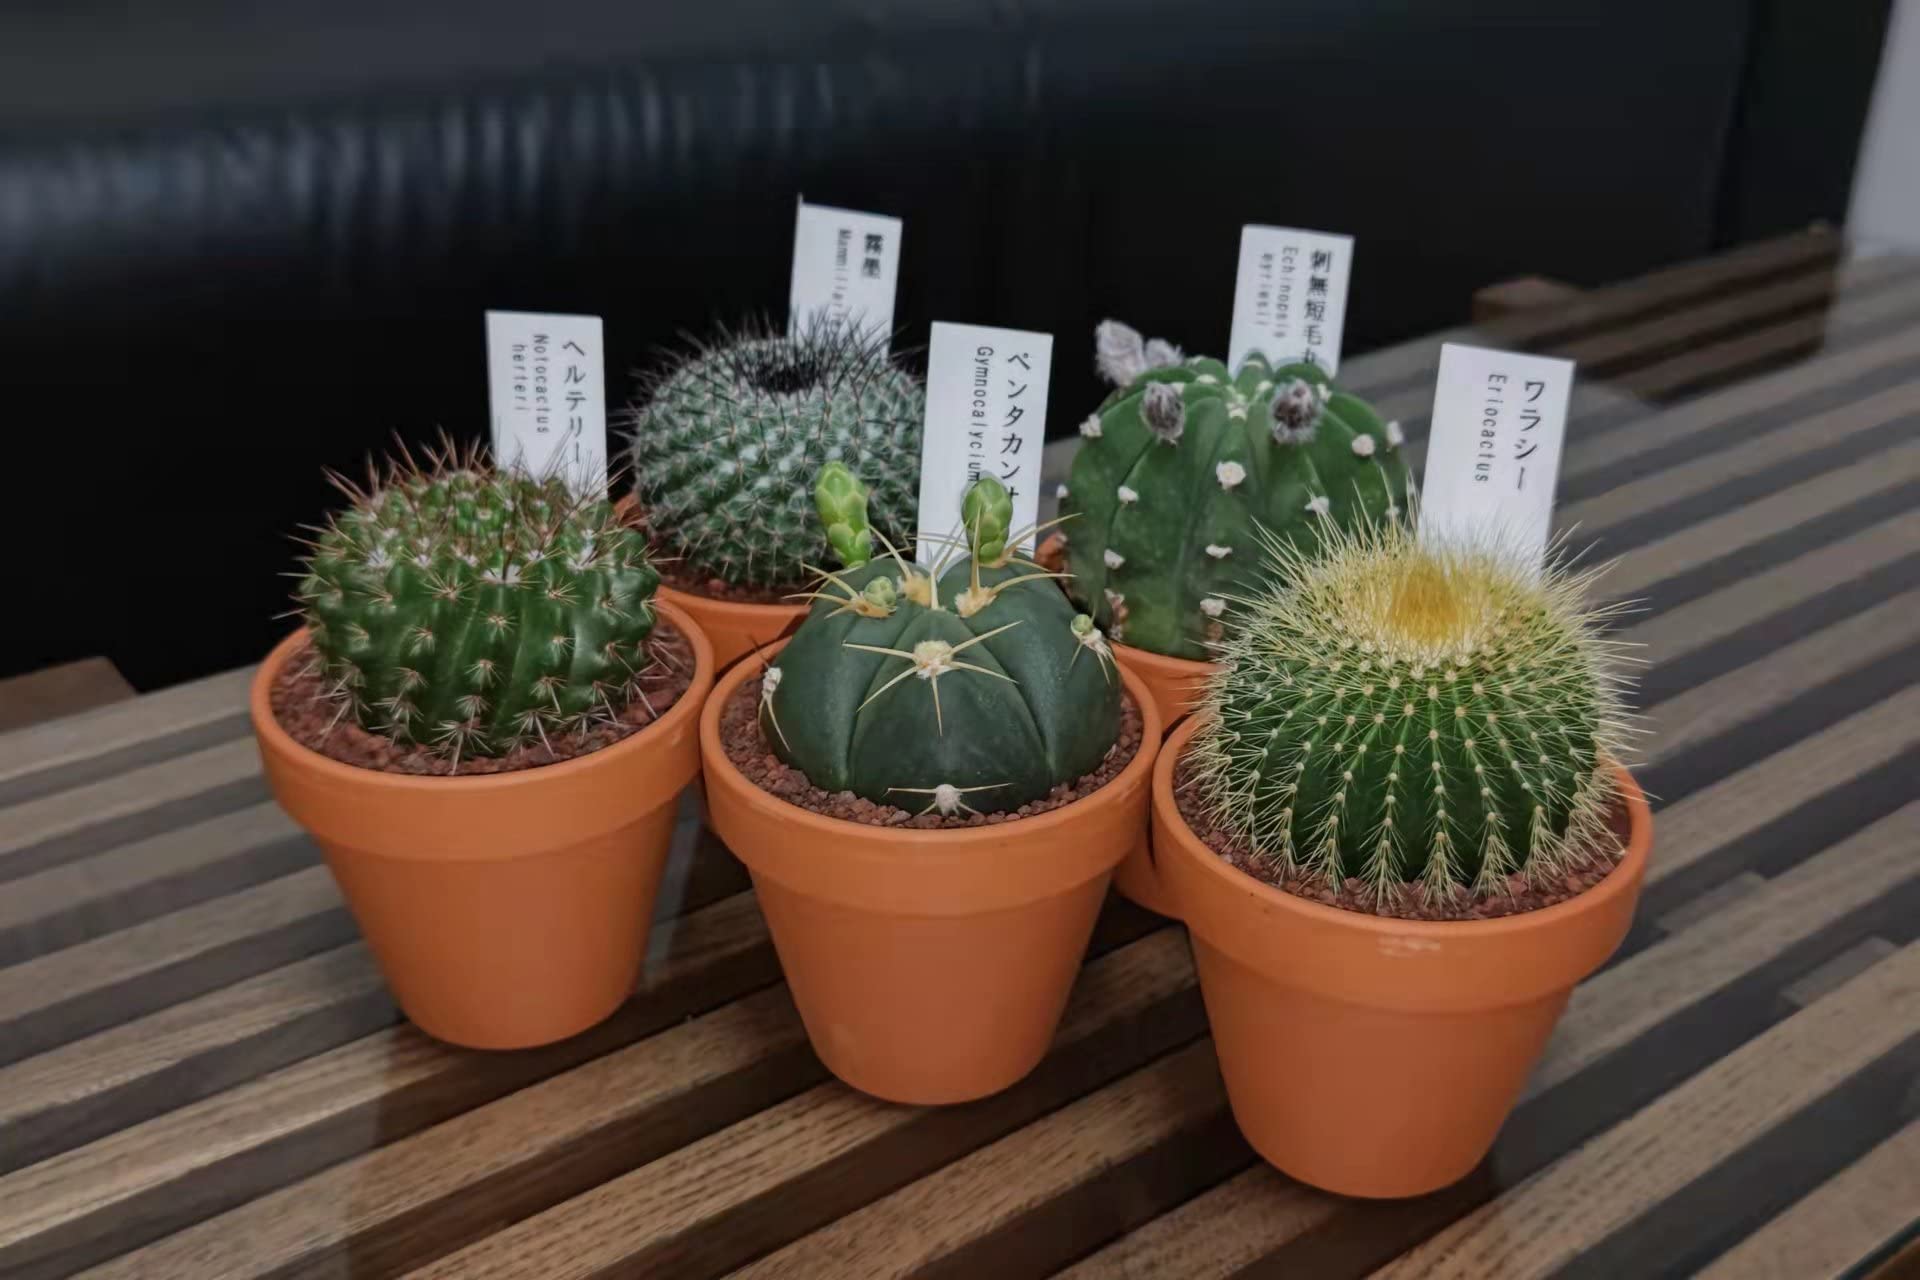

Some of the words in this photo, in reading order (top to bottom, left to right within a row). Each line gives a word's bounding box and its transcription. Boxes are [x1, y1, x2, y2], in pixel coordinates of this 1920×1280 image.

[511, 343, 530, 411] herteri
[533, 333, 551, 434] Notocactus
[562, 340, 587, 464] ヘルテリー
[967, 346, 994, 483] Gymnocalycium
[1475, 373, 1508, 482] Eriocactus
[1514, 380, 1545, 490] ワラシー
